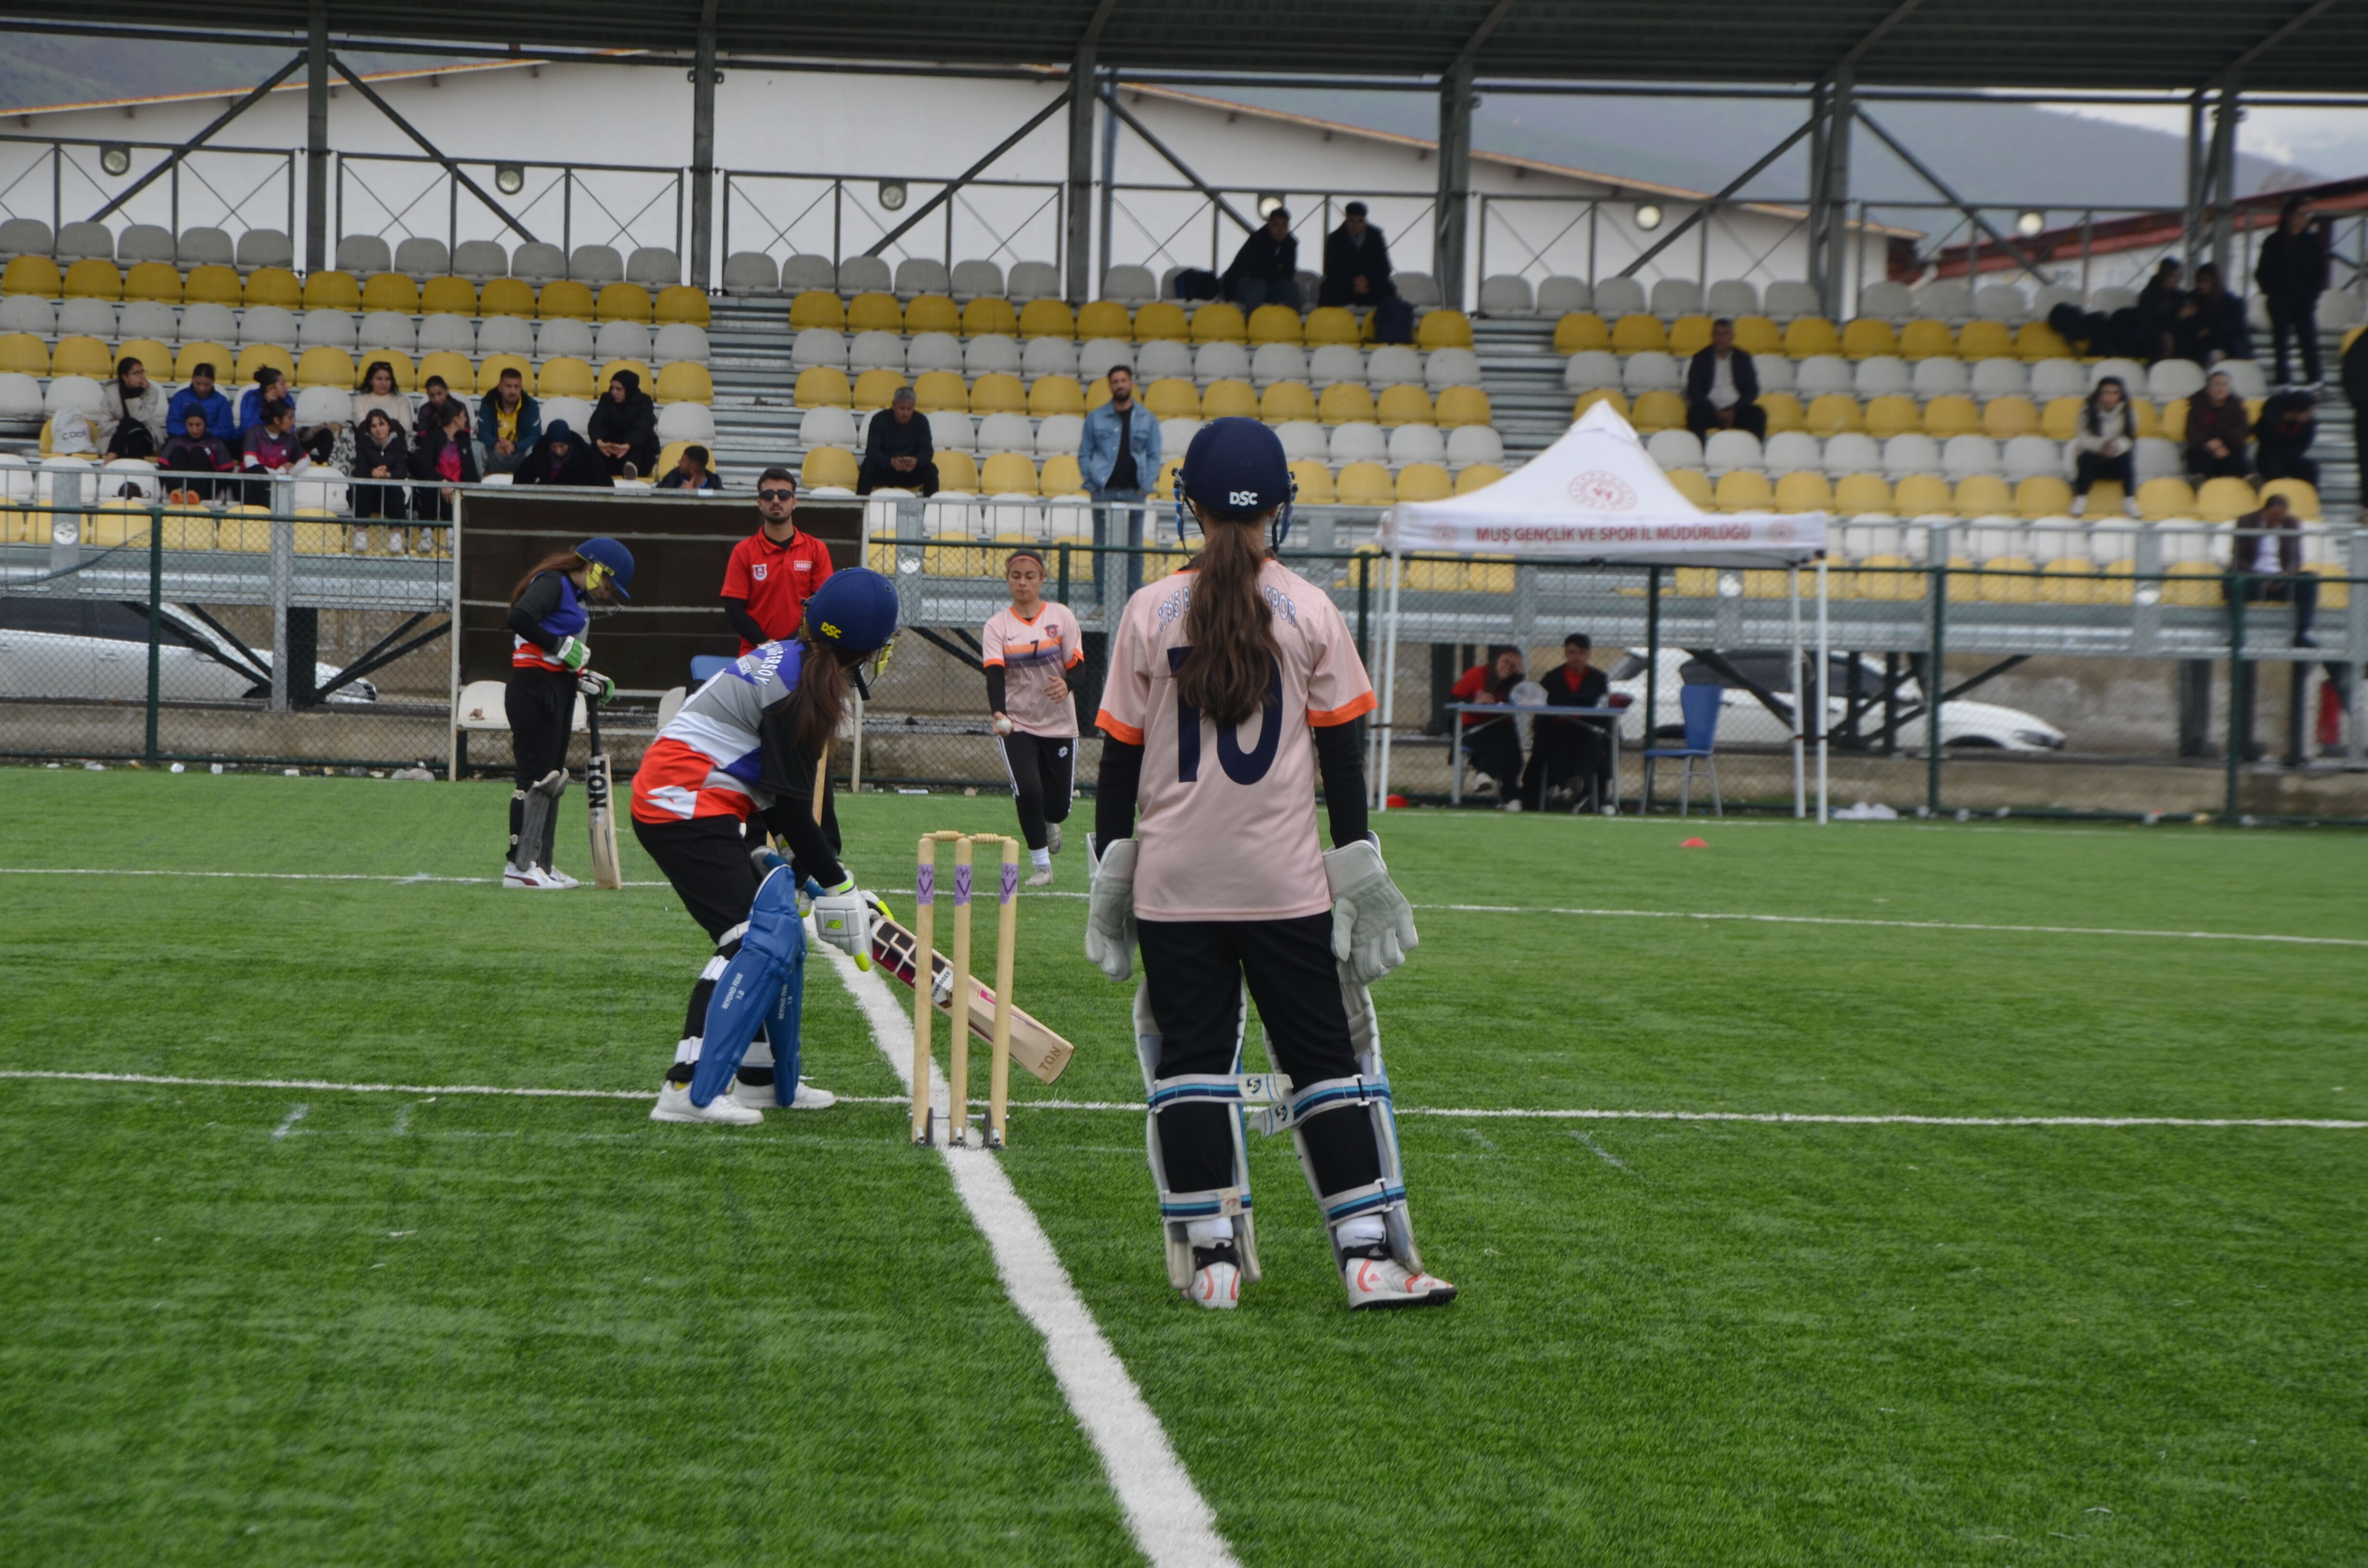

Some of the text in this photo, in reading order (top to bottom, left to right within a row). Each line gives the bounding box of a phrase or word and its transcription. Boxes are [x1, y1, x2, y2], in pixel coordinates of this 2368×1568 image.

[1229, 490, 1258, 506] DSC
[1477, 527, 1511, 545] MUŞ
[1515, 525, 1576, 544] GENÇLİK
[1579, 527, 1597, 541] VE
[1600, 527, 1637, 541] SPOR
[1657, 523, 1751, 540] MÜDÜRLÜĞÜ
[1265, 585, 1296, 628] SPOR
[821, 622, 842, 638] DSC
[1030, 639, 1039, 659] 7
[1167, 646, 1283, 785] 10
[587, 760, 607, 808] TON
[1038, 1045, 1061, 1070] TON
